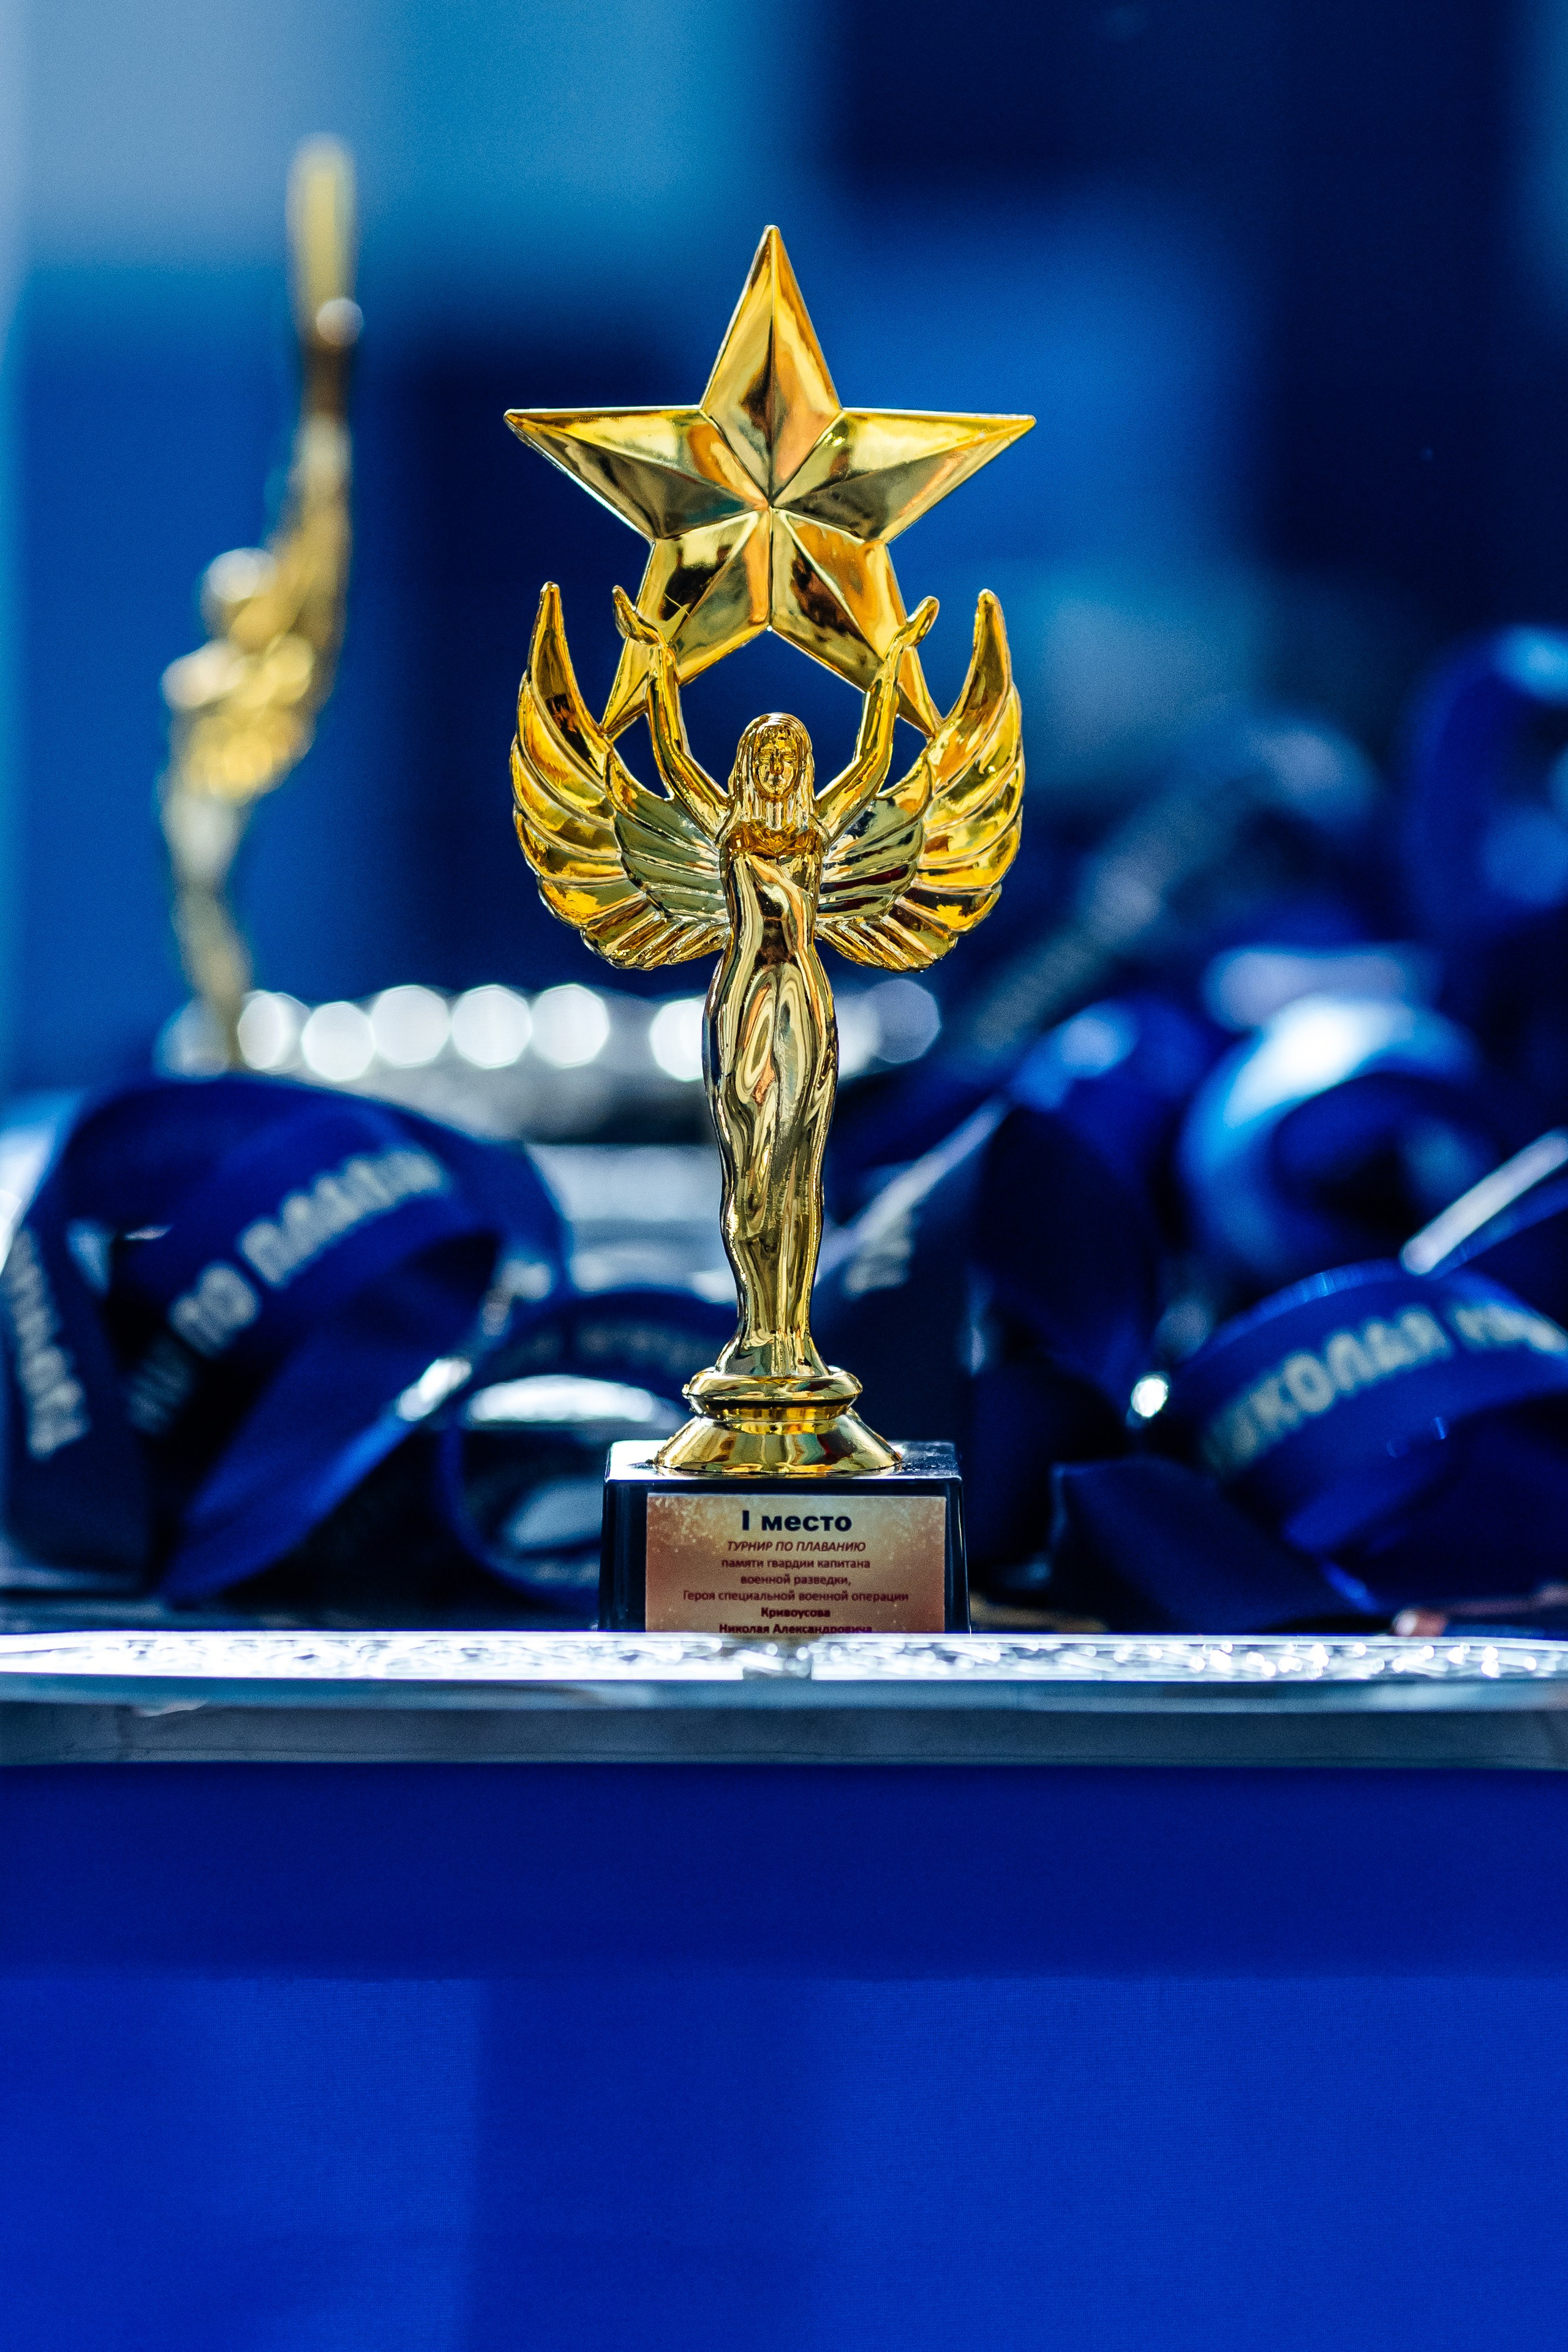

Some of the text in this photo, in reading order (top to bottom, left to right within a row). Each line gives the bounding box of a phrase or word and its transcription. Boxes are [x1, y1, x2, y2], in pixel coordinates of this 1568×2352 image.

[742, 1510, 852, 1532] I место
[728, 1541, 866, 1551] ТУРНИР ПО ПЛАВАНИЮ
[722, 1559, 870, 1569] памяти гвардии капитана
[741, 1574, 851, 1586] военной разведки,
[683, 1589, 909, 1603] Героя специальной военной операции
[761, 1607, 831, 1619] Кривоусова
[719, 1624, 872, 1634] Николая Александровича
